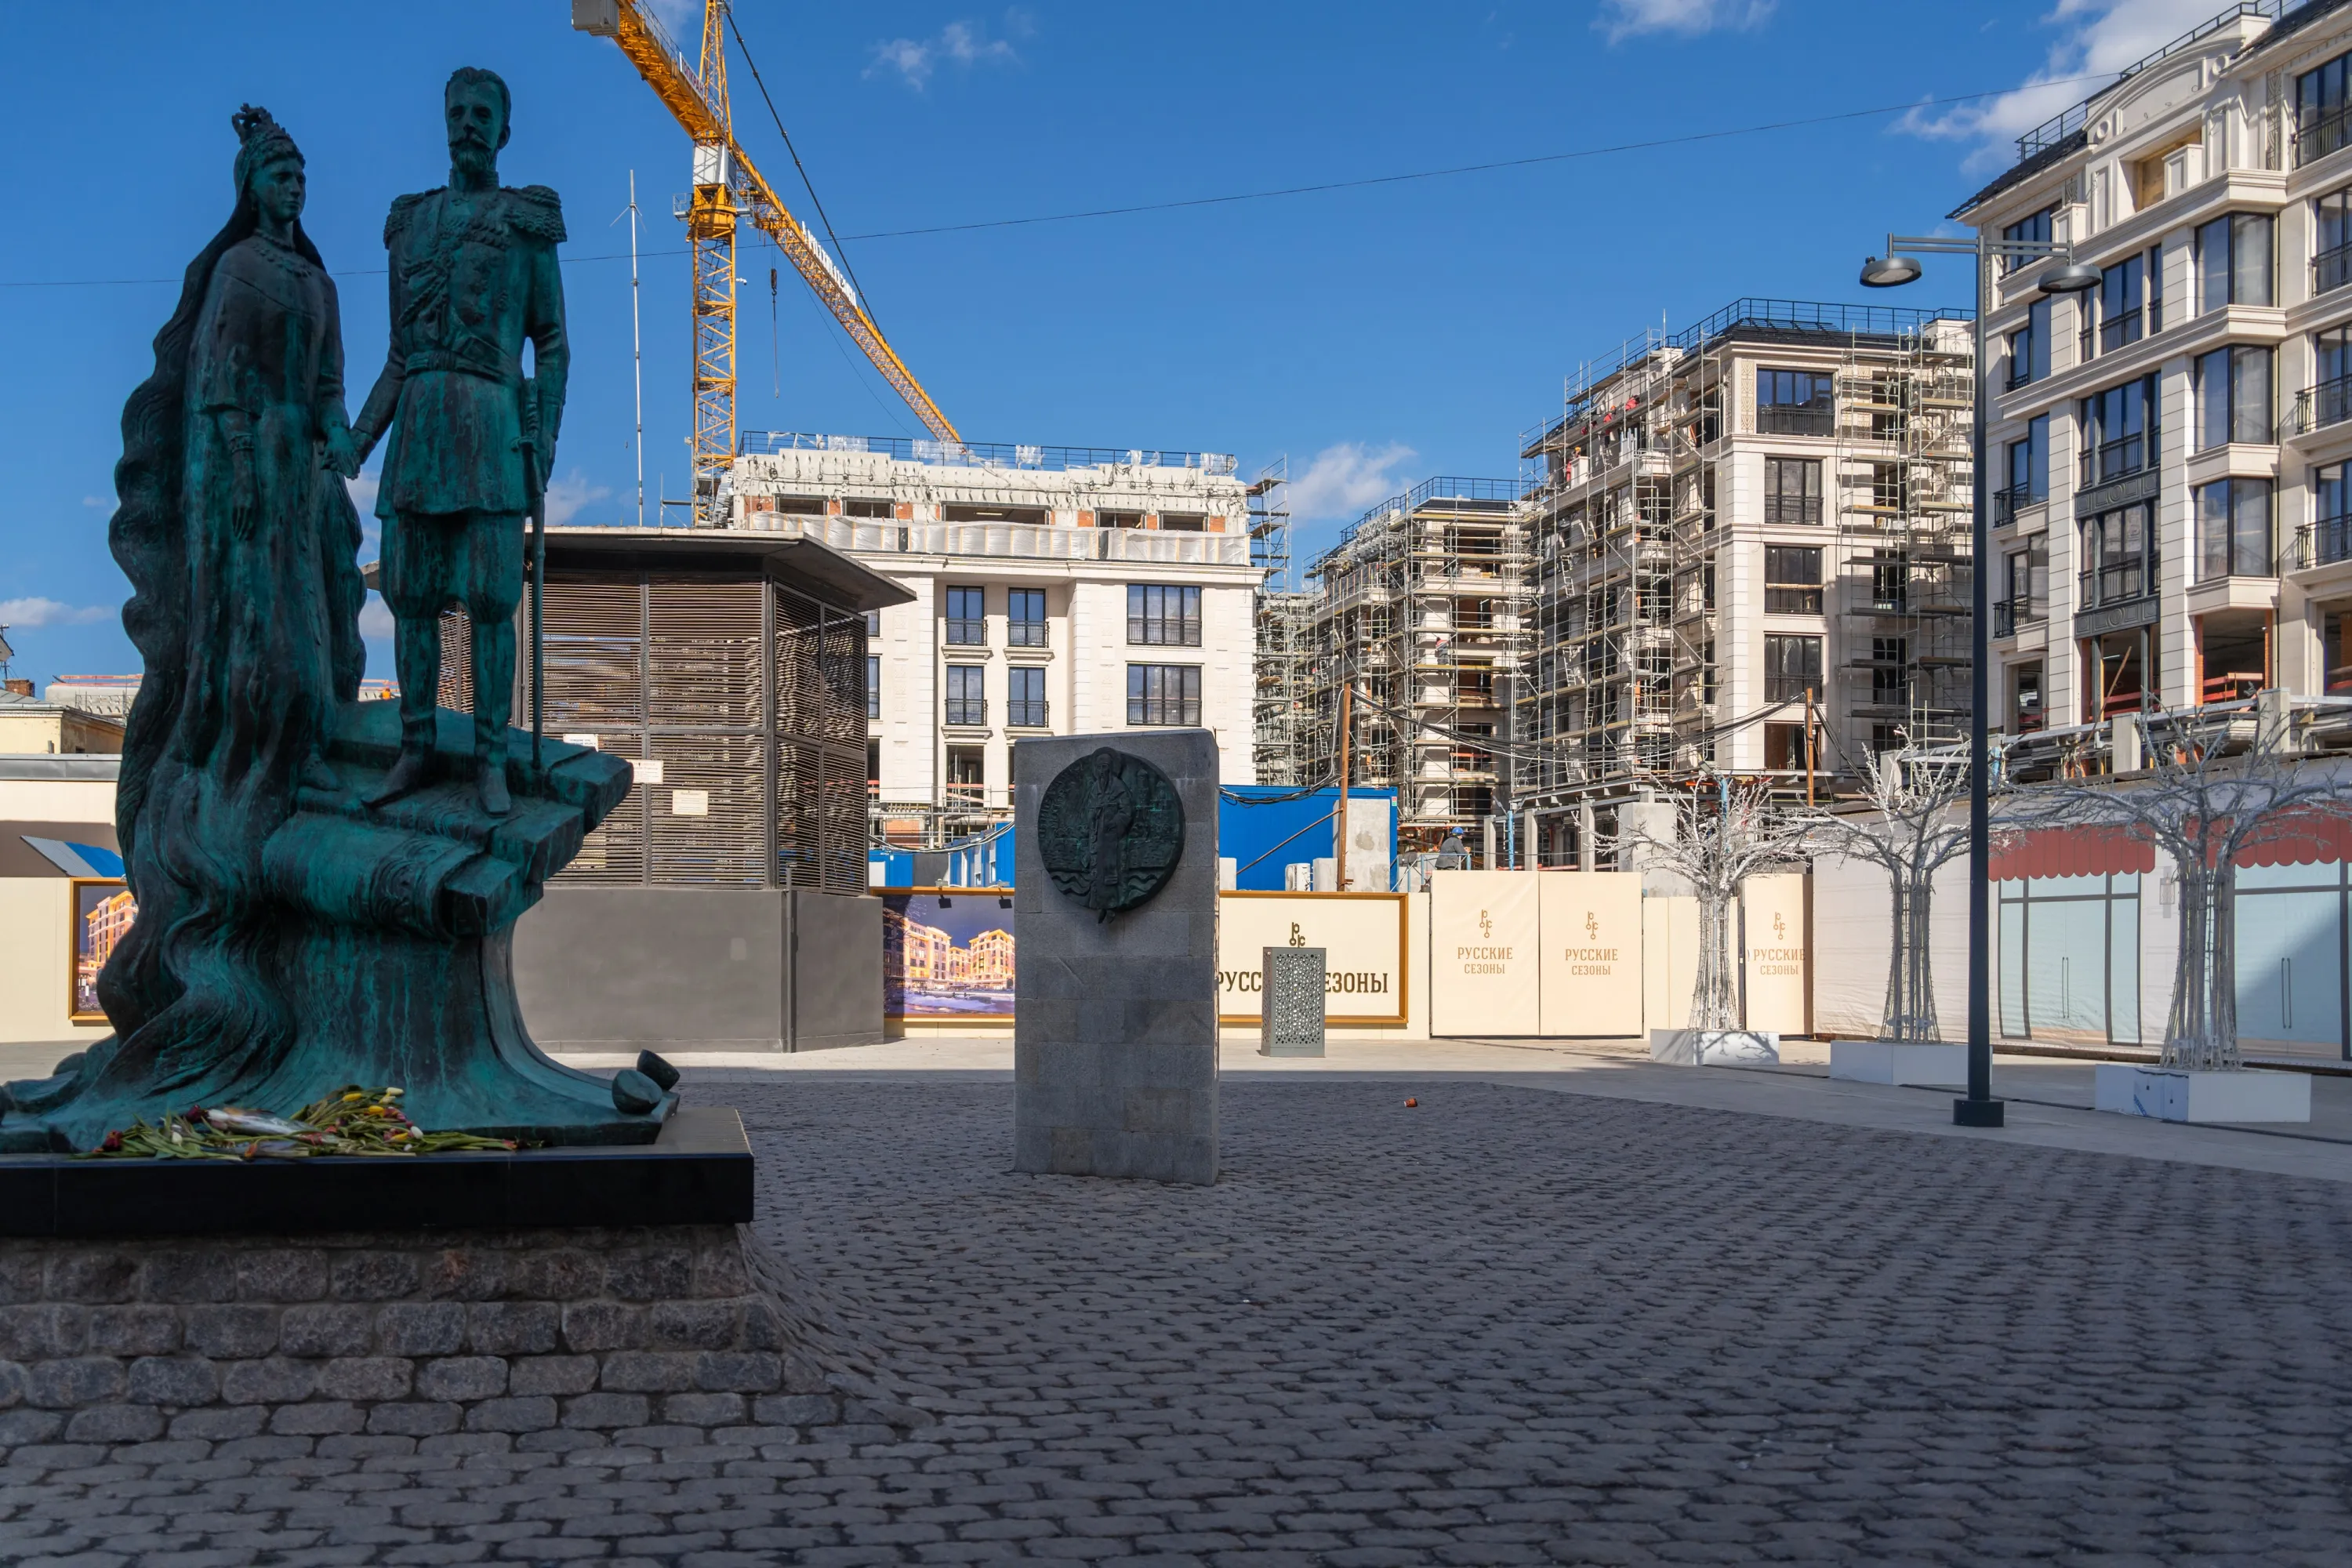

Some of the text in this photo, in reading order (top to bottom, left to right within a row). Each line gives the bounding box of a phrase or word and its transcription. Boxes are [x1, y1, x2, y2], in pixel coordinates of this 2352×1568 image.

[1457, 947, 1513, 960] РУССКИЕ
[1565, 949, 1618, 961] РУССКИЕ
[1753, 949, 1806, 960] РУССКИЕ
[1464, 964, 1505, 974] СЕЗОНЫ
[1571, 965, 1611, 975] СЕЗОНЫ
[1760, 965, 1798, 975] СЕЗОНЫ
